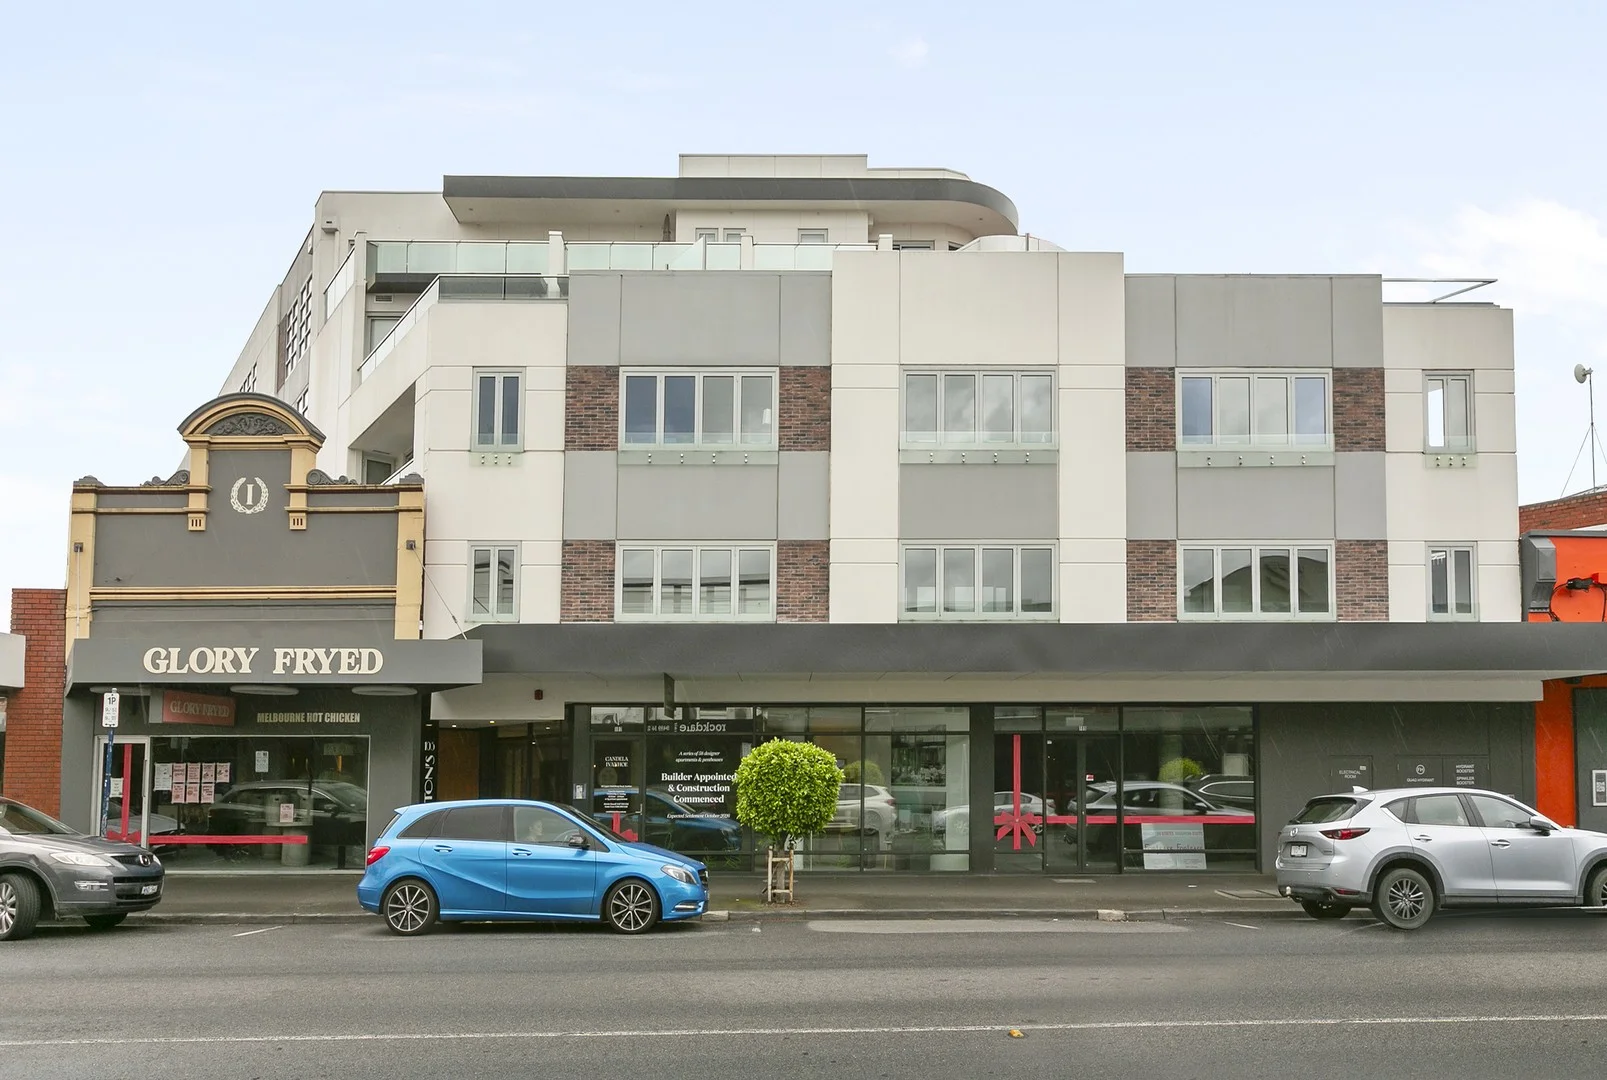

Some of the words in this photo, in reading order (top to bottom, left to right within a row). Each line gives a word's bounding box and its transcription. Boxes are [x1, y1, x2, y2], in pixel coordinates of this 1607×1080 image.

[143, 647, 259, 674] GLORY
[272, 647, 384, 674] FRYED
[108, 697, 116, 705] 1P
[170, 700, 201, 715] GLORY
[202, 703, 230, 718] FRYED
[257, 712, 305, 723] MELBOURNE
[306, 712, 323, 723] HOT
[324, 712, 360, 723] CHICKEN
[424, 755, 435, 803] TON'S
[661, 772, 692, 781] Builder
[694, 772, 738, 783] Appointed
[668, 784, 675, 792] &
[676, 783, 730, 792] Construction
[673, 794, 725, 803] Commenced
